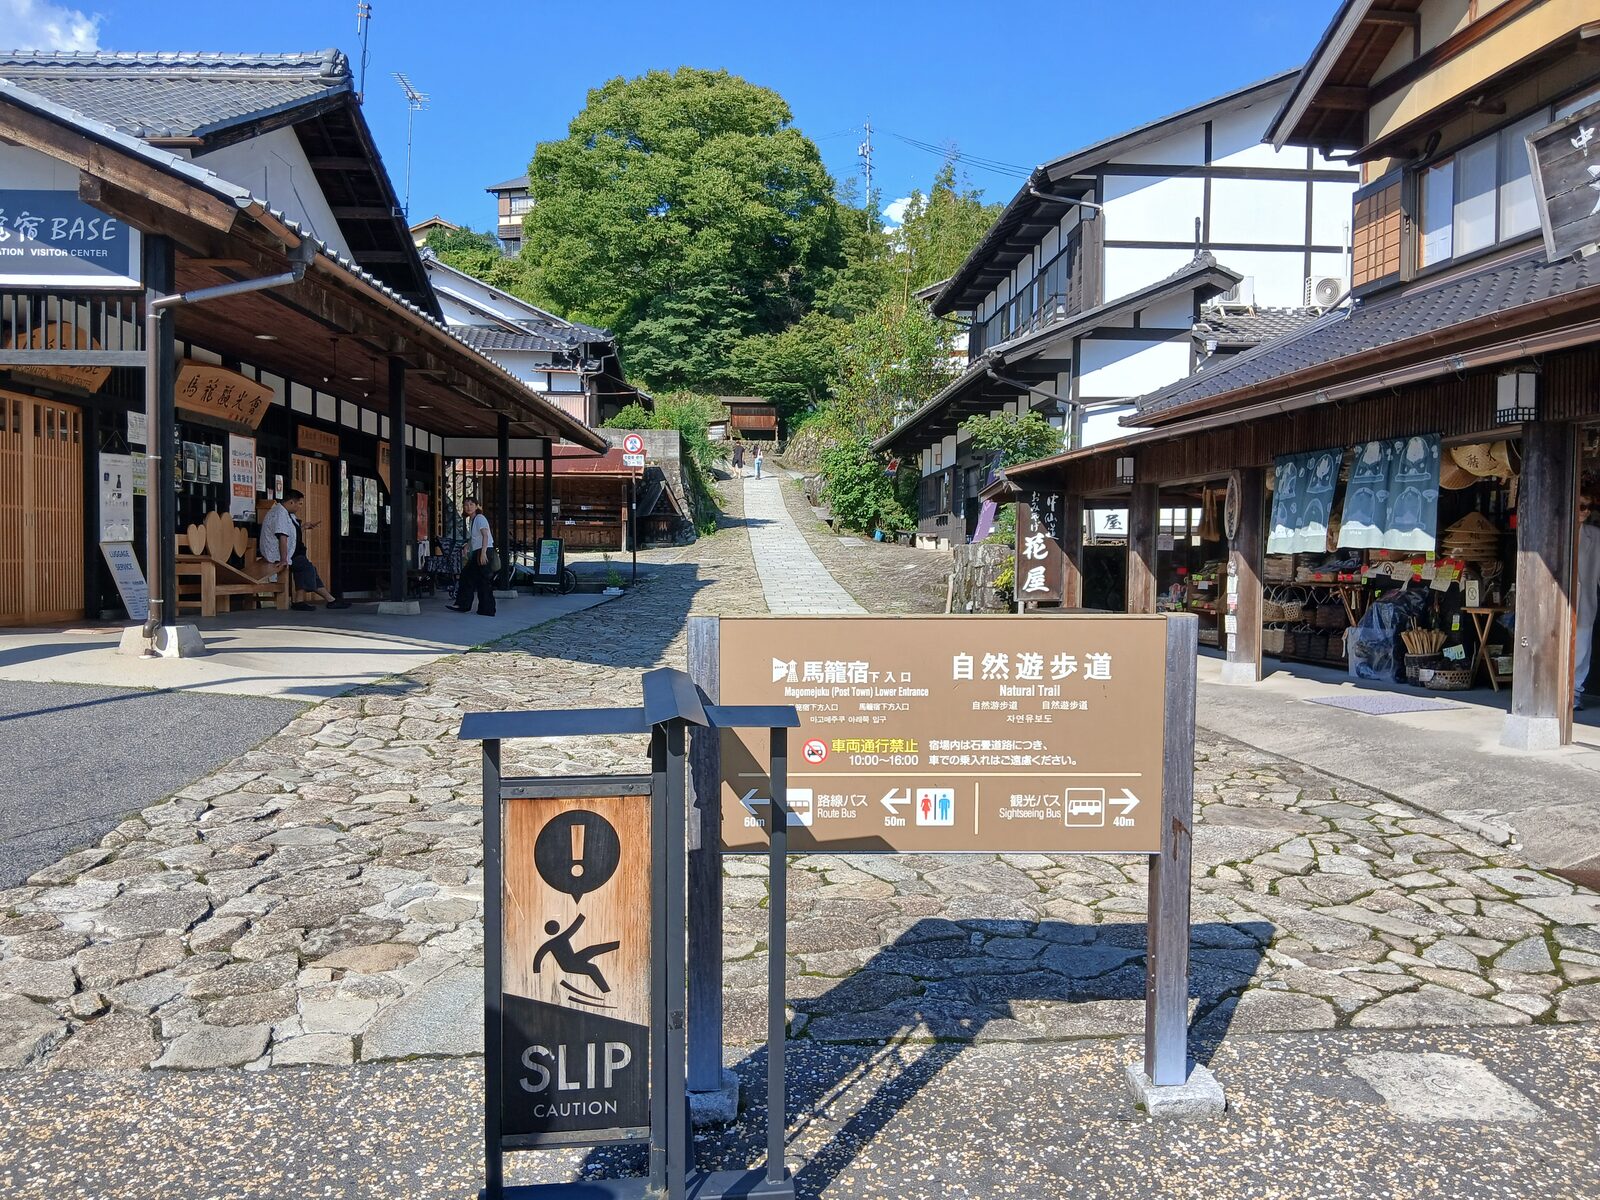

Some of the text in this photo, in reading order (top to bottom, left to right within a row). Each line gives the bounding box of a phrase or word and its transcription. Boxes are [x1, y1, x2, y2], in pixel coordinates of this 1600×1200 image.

[51, 217, 117, 241] BASE
[31, 248, 68, 256] VISITOR
[70, 249, 108, 257] CENTER
[1022, 532, 1050, 592] 花屋
[953, 652, 1112, 680] 自然遊歩道
[784, 686, 929, 698] Magomejuku (Post Town) Lower Entrance
[1000, 684, 1061, 697] Natural Trail
[1006, 714, 1053, 724] 자연유보도
[832, 738, 919, 753] 車両通行禁止
[817, 794, 868, 808] 路線バス
[1010, 794, 1061, 807] 観光バス
[817, 808, 857, 819] Route Bus
[999, 807, 1062, 820] Sightseeing Bus
[744, 817, 765, 828] 60m
[884, 816, 906, 828] 50m
[1113, 816, 1135, 827] 40m
[519, 1042, 632, 1093] SLIP
[533, 1100, 617, 1118] CAUTION
